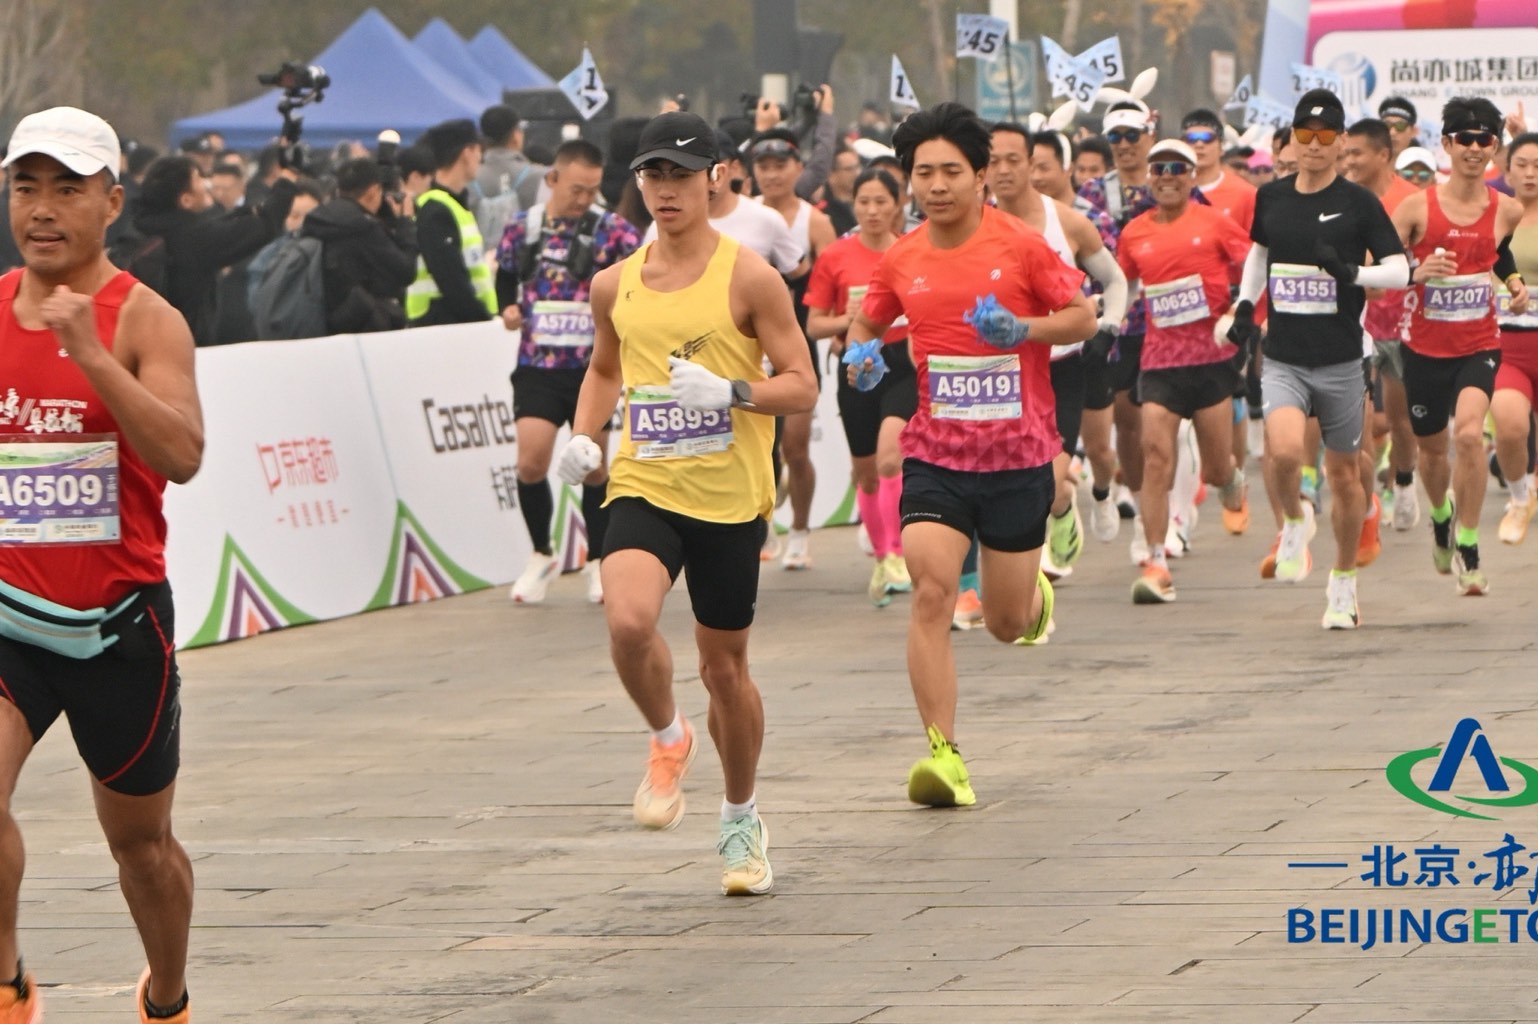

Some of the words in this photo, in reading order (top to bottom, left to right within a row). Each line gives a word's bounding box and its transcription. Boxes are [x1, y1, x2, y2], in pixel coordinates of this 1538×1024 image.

[1392, 87, 1438, 97] SHANG
[1274, 278, 1329, 297] A3155
[1430, 288, 1484, 305] A1207
[1152, 292, 1198, 313] A0629
[937, 374, 1011, 397] A5019
[421, 393, 516, 454] Casarte
[636, 407, 720, 432] A5895
